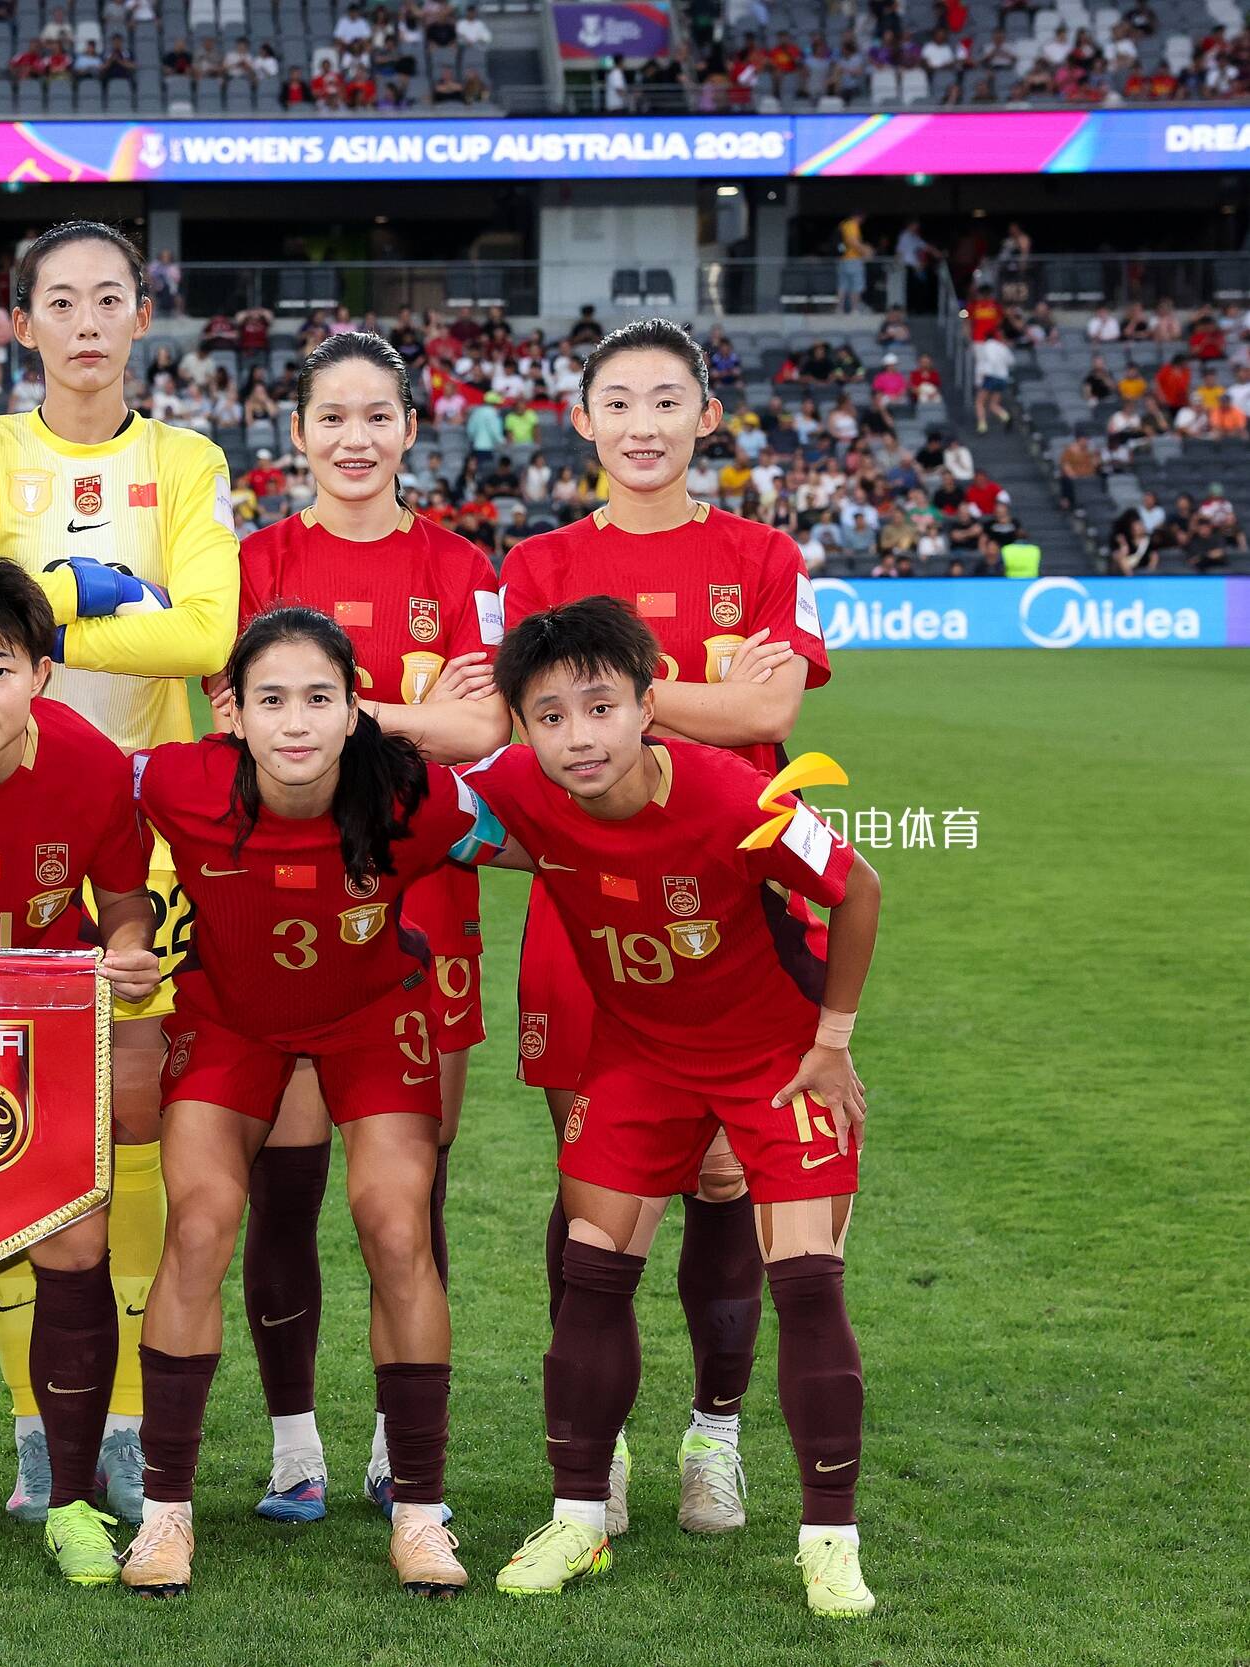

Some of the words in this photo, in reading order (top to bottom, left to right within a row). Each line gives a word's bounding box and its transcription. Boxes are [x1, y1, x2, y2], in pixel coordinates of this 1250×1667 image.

[183, 136, 324, 164] WOMEN'S
[328, 135, 423, 163] ASIAN
[425, 135, 491, 163] CUP
[492, 132, 691, 162] AUSTRALIA
[694, 131, 785, 160] 2026
[76, 477, 101, 487] CFA
[411, 600, 436, 611] CFA
[712, 587, 738, 596] CFA
[826, 599, 969, 642] Midea
[1046, 598, 1201, 642] Midea
[38, 845, 65, 855] CFA
[666, 878, 695, 886] CFA
[273, 919, 318, 970] 3
[591, 925, 675, 984] 19
[395, 1010, 431, 1065] 3
